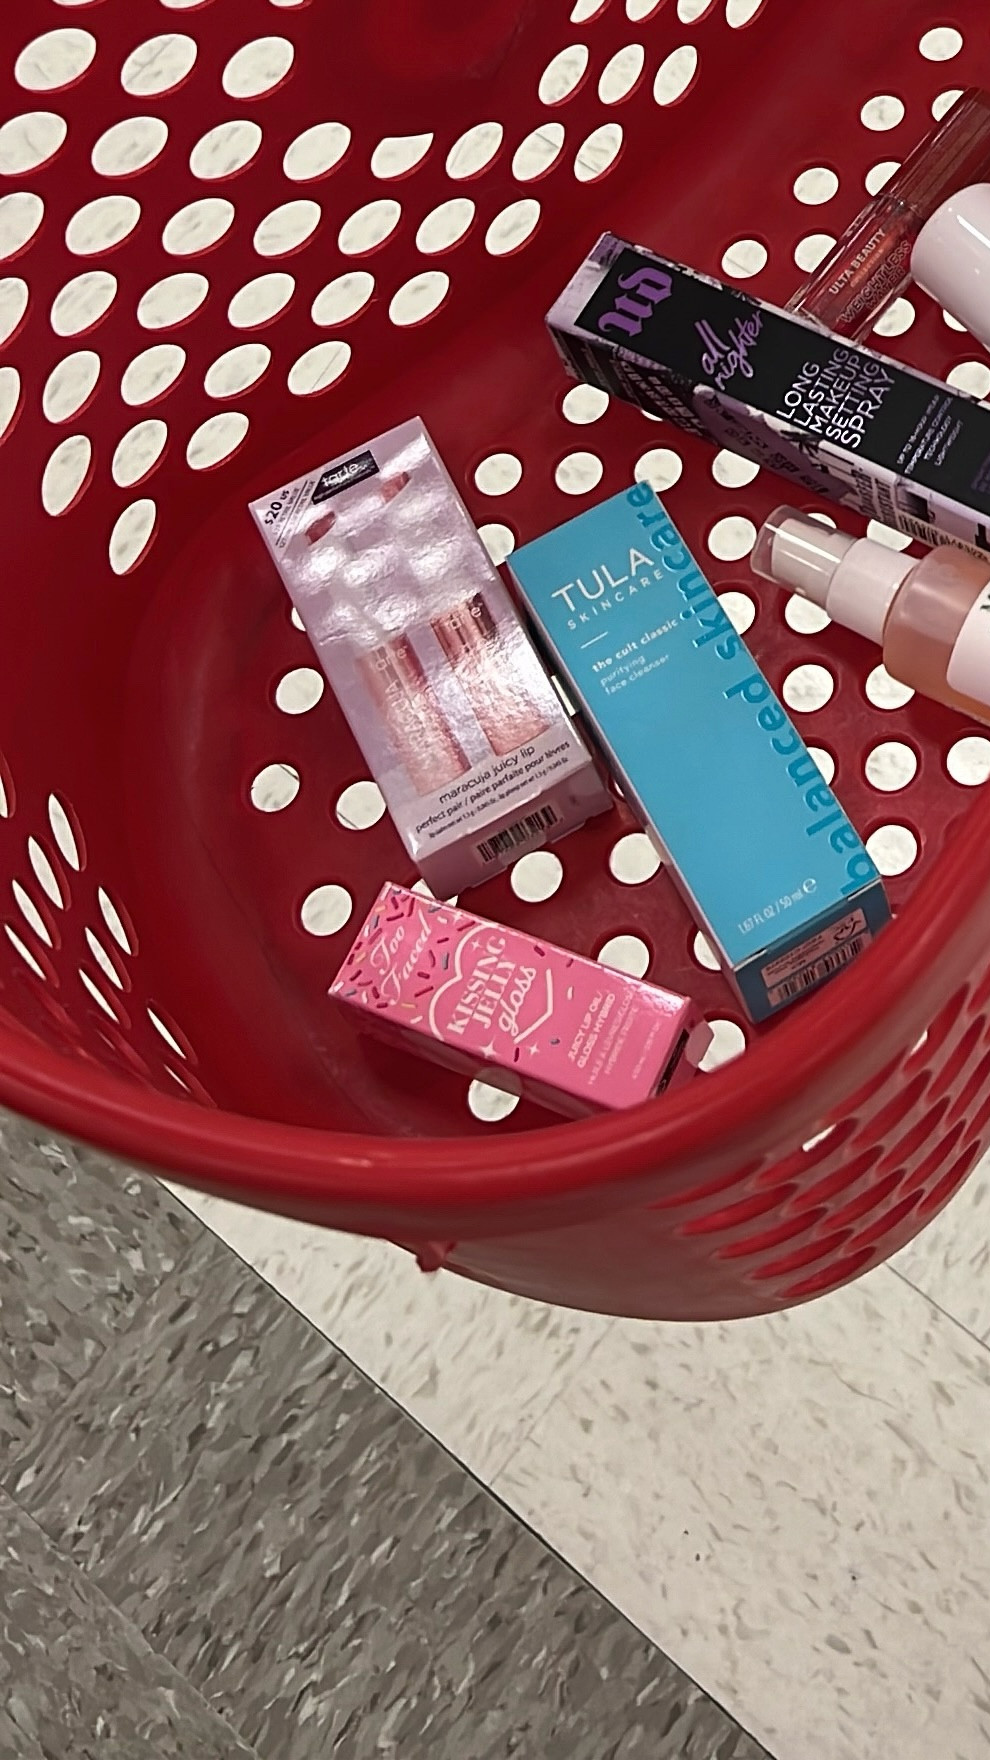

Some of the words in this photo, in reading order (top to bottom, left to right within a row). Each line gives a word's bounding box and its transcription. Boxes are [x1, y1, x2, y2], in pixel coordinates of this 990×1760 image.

[828, 268, 854, 295] ULTA
[850, 228, 887, 269] BEAUTY
[841, 240, 912, 323] WEIGHTLESS
[694, 317, 731, 376] all
[713, 309, 764, 391] nighter
[775, 361, 820, 419] LONG
[793, 347, 849, 427] LASTING
[808, 354, 861, 435] MAKEUP
[825, 361, 880, 441] SETTING
[840, 367, 895, 448] SPRAY
[551, 547, 655, 613] TULA
[567, 568, 664, 631] SKINCARE
[625, 480, 747, 662] skincare
[592, 656, 613, 673] the
[615, 641, 639, 660] cult
[640, 618, 679, 645] classic
[600, 655, 647, 687] purifying
[604, 678, 628, 696] face
[628, 654, 670, 682] cleanser
[415, 811, 447, 834] perfect
[446, 801, 464, 817] pair
[469, 787, 492, 805] paire
[491, 768, 525, 791] parfaite
[524, 756, 545, 772] pour
[438, 771, 492, 804] maracuja
[491, 754, 519, 777] juicy
[521, 745, 537, 760] lip
[722, 678, 878, 896] balanced
[369, 924, 406, 976] Too
[380, 908, 433, 1007] Faced
[446, 935, 507, 1036] KISSING
[471, 958, 517, 1030] JELLY
[498, 964, 538, 1037] gloss
[567, 1028, 586, 1062] JUICY
[577, 1033, 598, 1069] GLOSS
[593, 993, 616, 1033] HYBRID
